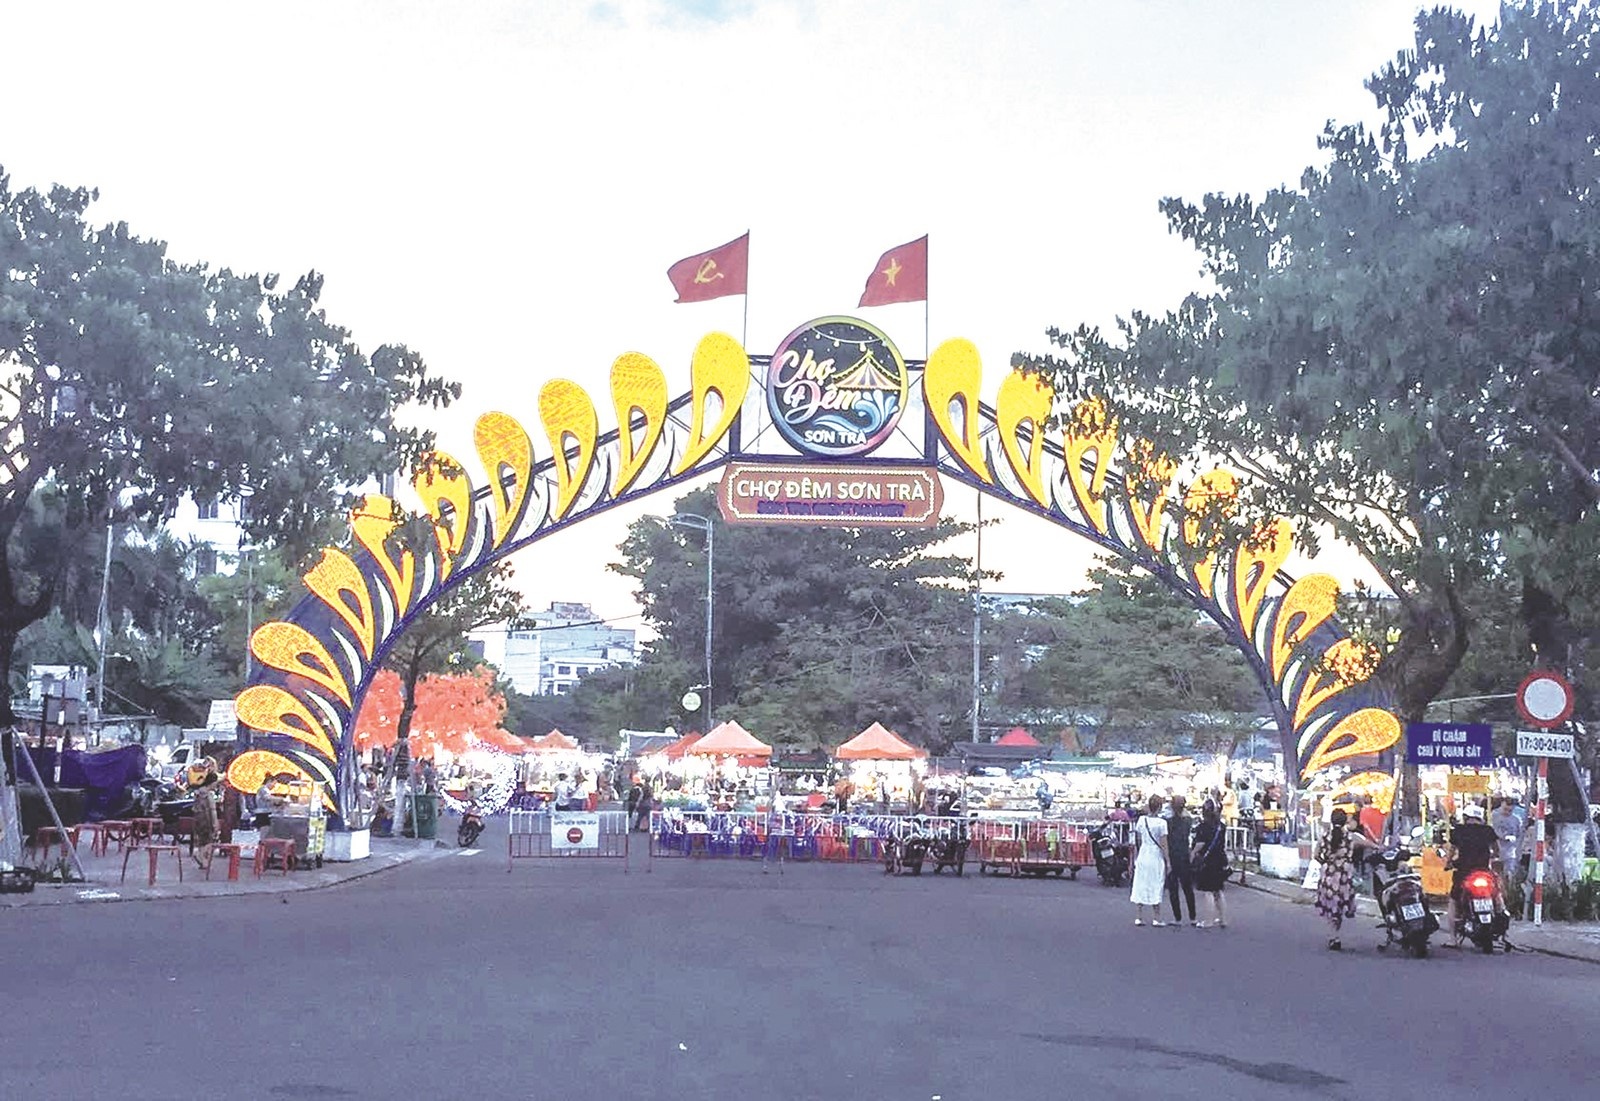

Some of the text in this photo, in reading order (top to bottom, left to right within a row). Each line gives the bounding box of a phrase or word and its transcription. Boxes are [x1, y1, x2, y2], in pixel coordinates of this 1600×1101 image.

[773, 349, 836, 388] Chợ
[783, 379, 857, 424] Đêm
[804, 429, 836, 444] SƠN
[737, 477, 926, 501] CHỢ ĐÊM SƠN TRÀ
[1519, 736, 1572, 752] 17:30-24:00
